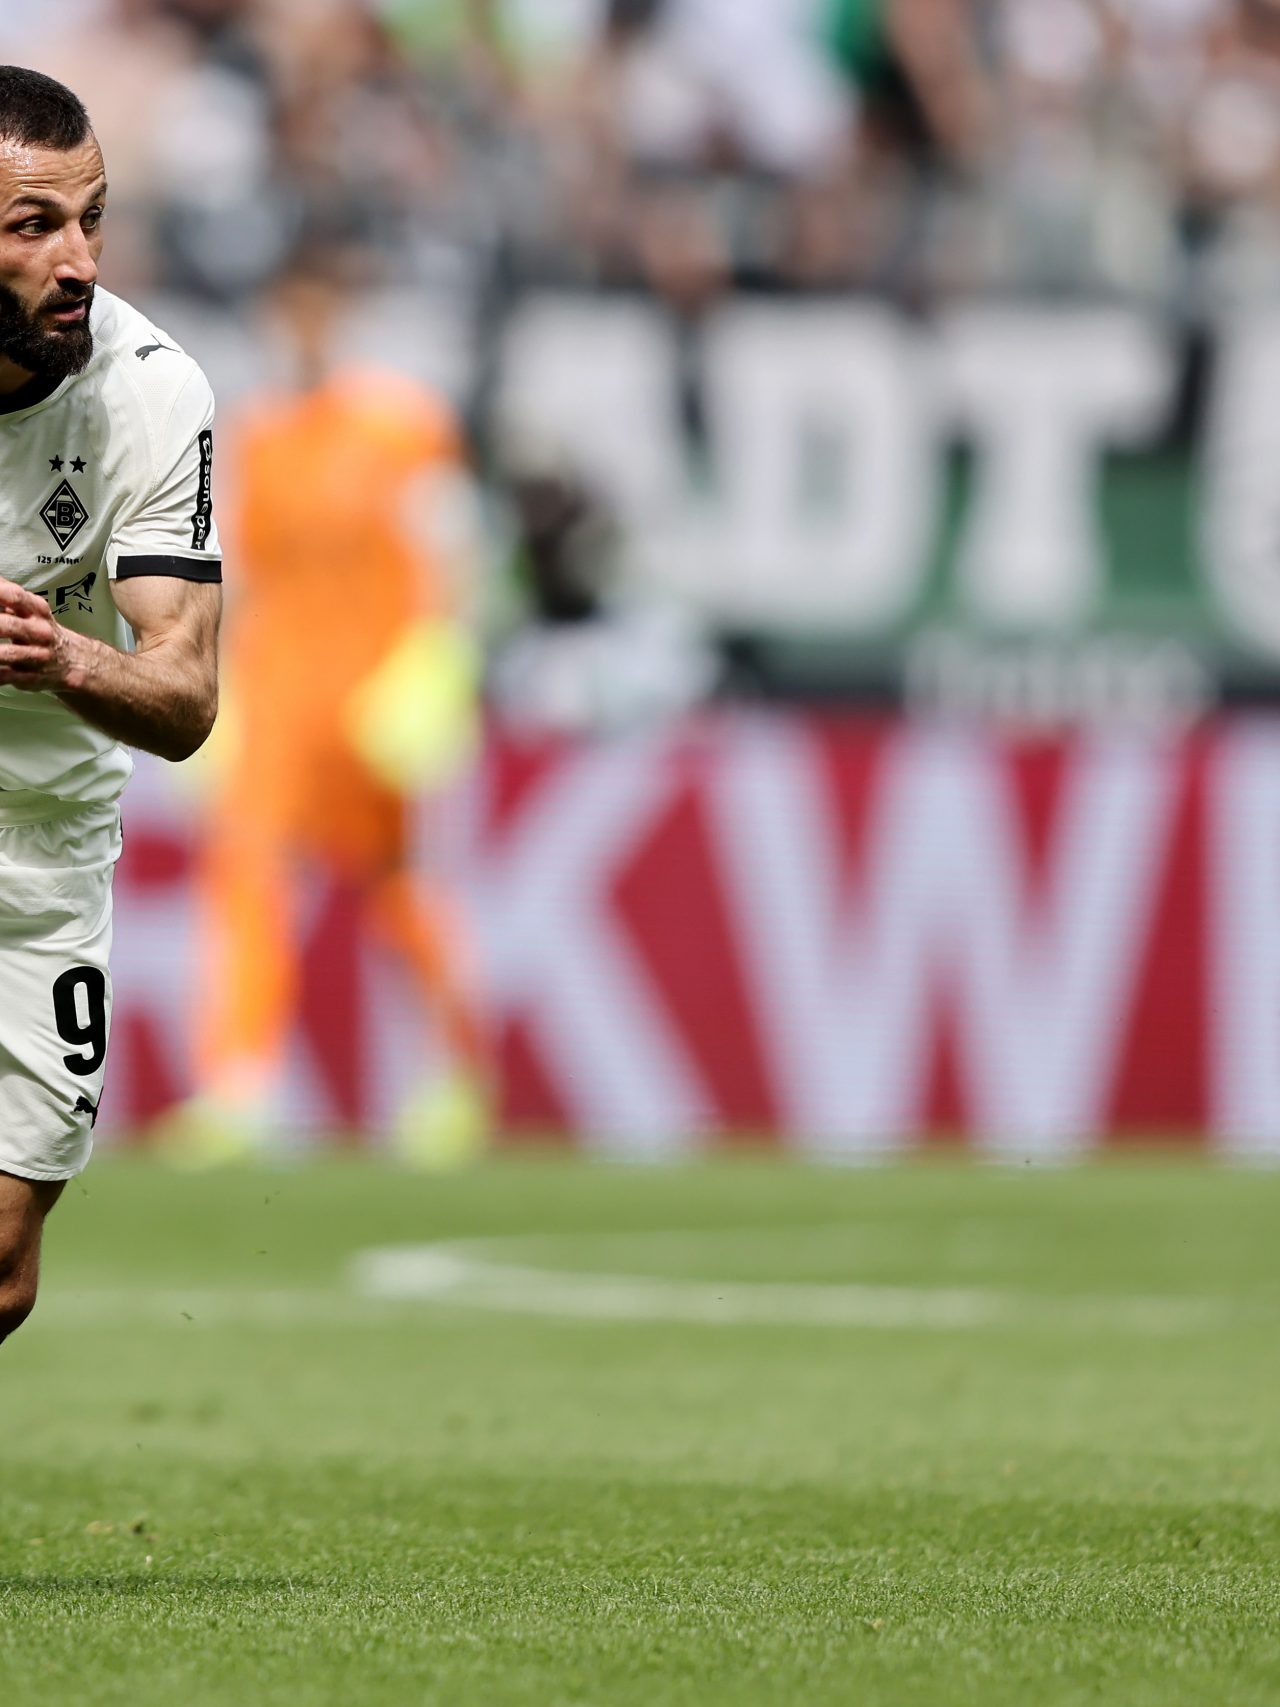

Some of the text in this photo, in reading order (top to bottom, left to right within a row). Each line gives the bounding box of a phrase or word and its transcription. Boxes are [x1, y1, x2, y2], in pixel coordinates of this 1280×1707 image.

[37, 555, 84, 565] 125 JAHR
[53, 966, 106, 1076] 9
